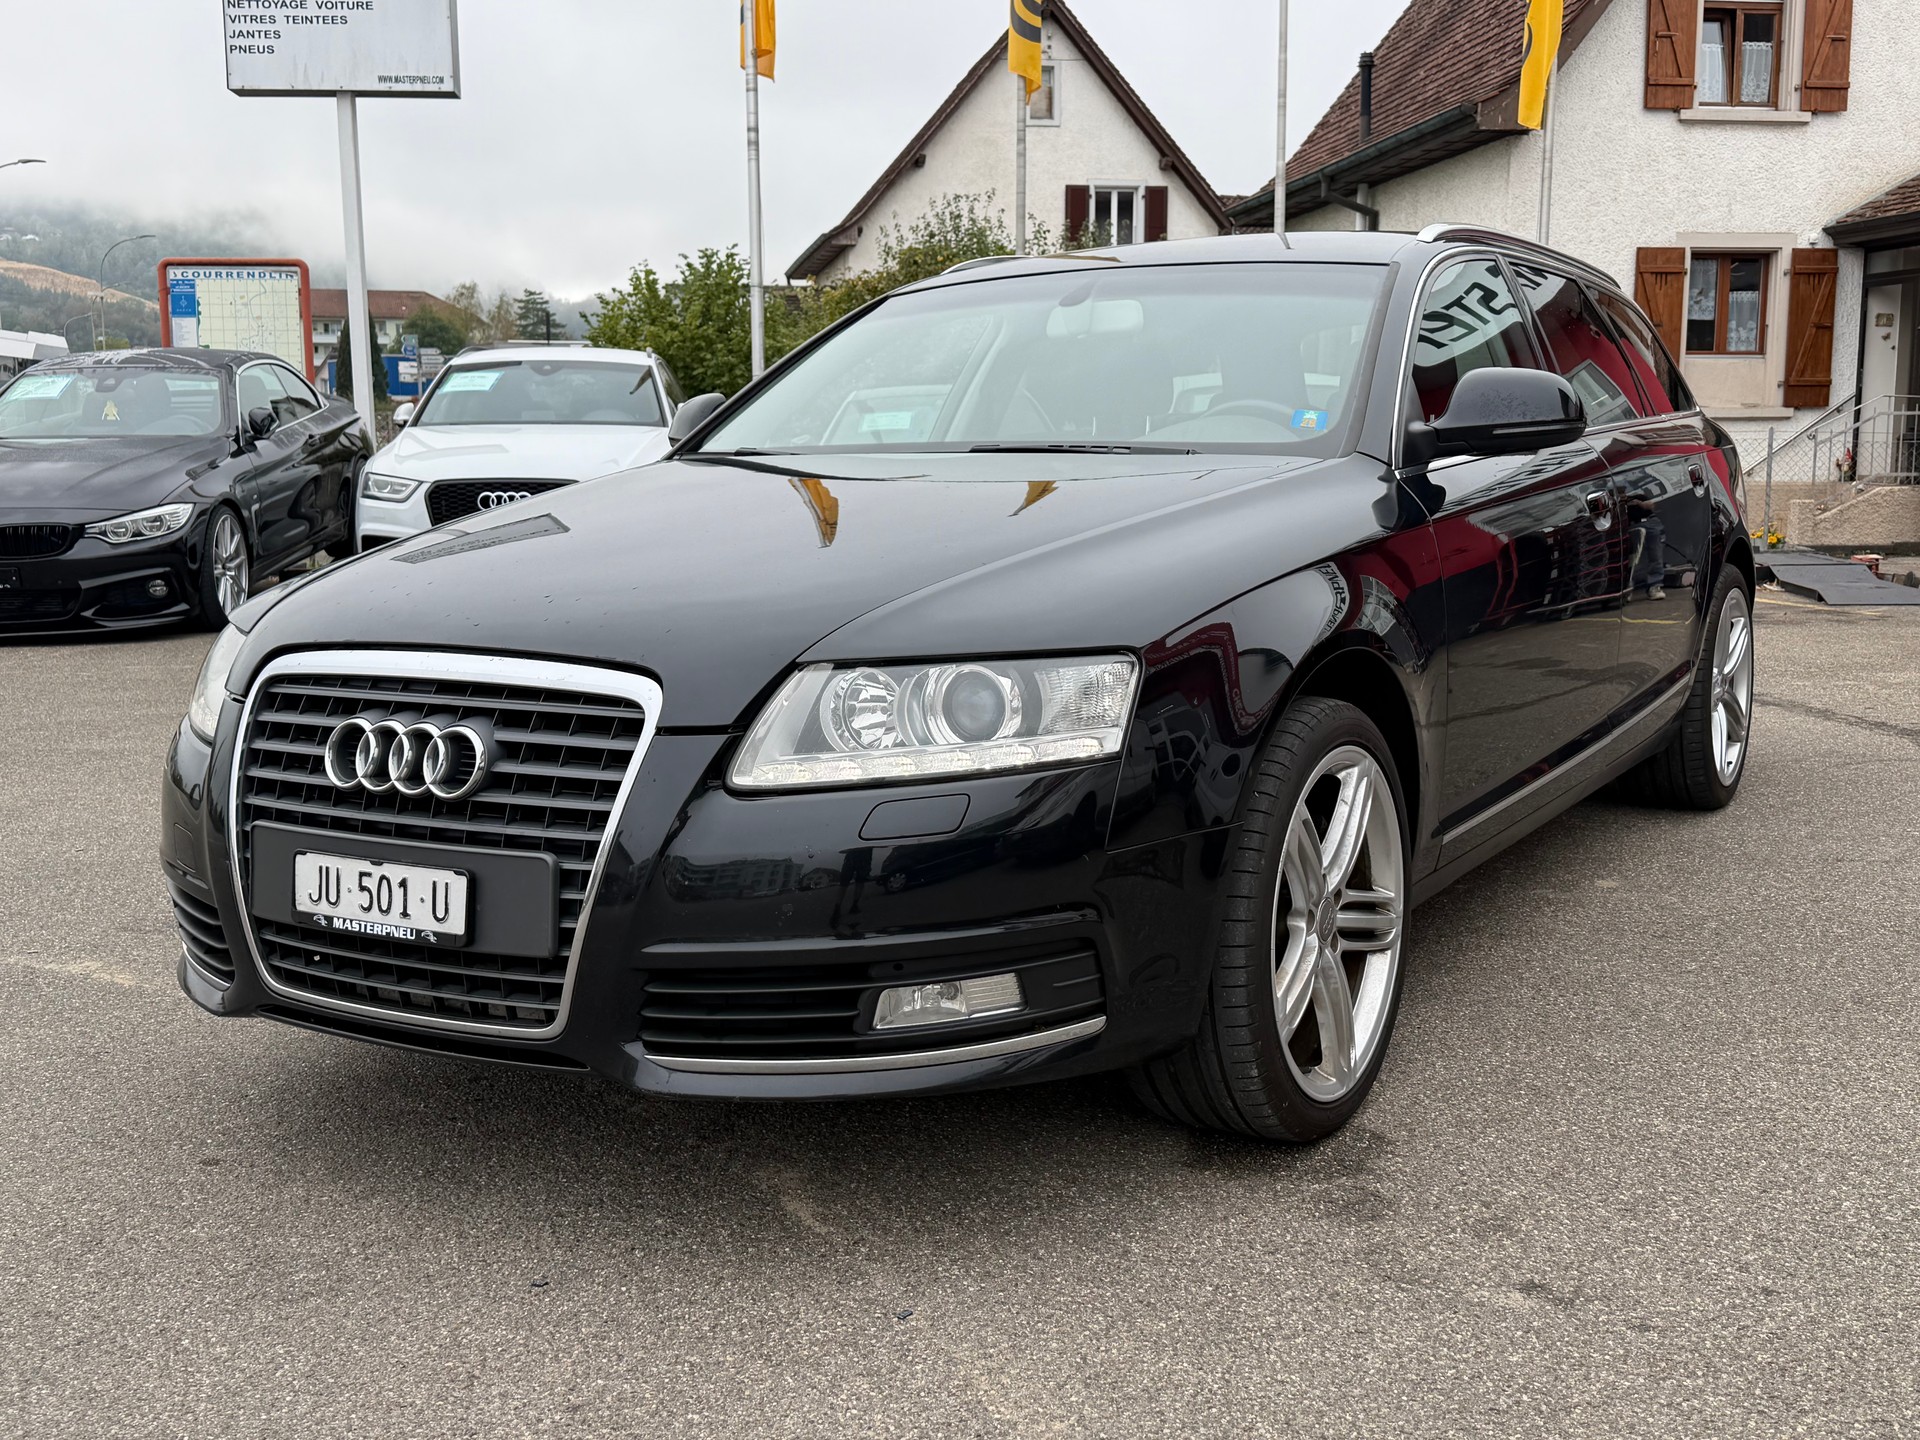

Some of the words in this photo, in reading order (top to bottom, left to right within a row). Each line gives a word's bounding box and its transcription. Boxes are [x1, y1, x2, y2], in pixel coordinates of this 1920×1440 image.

[227, 0, 308, 9] NETTOYAGE
[315, 0, 374, 11] VOITURE
[228, 14, 277, 25] VITRES
[283, 15, 348, 25] TEINTEES
[229, 29, 281, 39] JANTES
[229, 44, 275, 54] PNEUS
[377, 74, 445, 85] WWW.MASTERPNEU.COM
[180, 270, 294, 279] COURRENDLIN
[308, 864, 342, 908] JU
[356, 871, 412, 920] 501
[430, 880, 451, 925] U
[332, 917, 416, 940] MASTERPNEU
